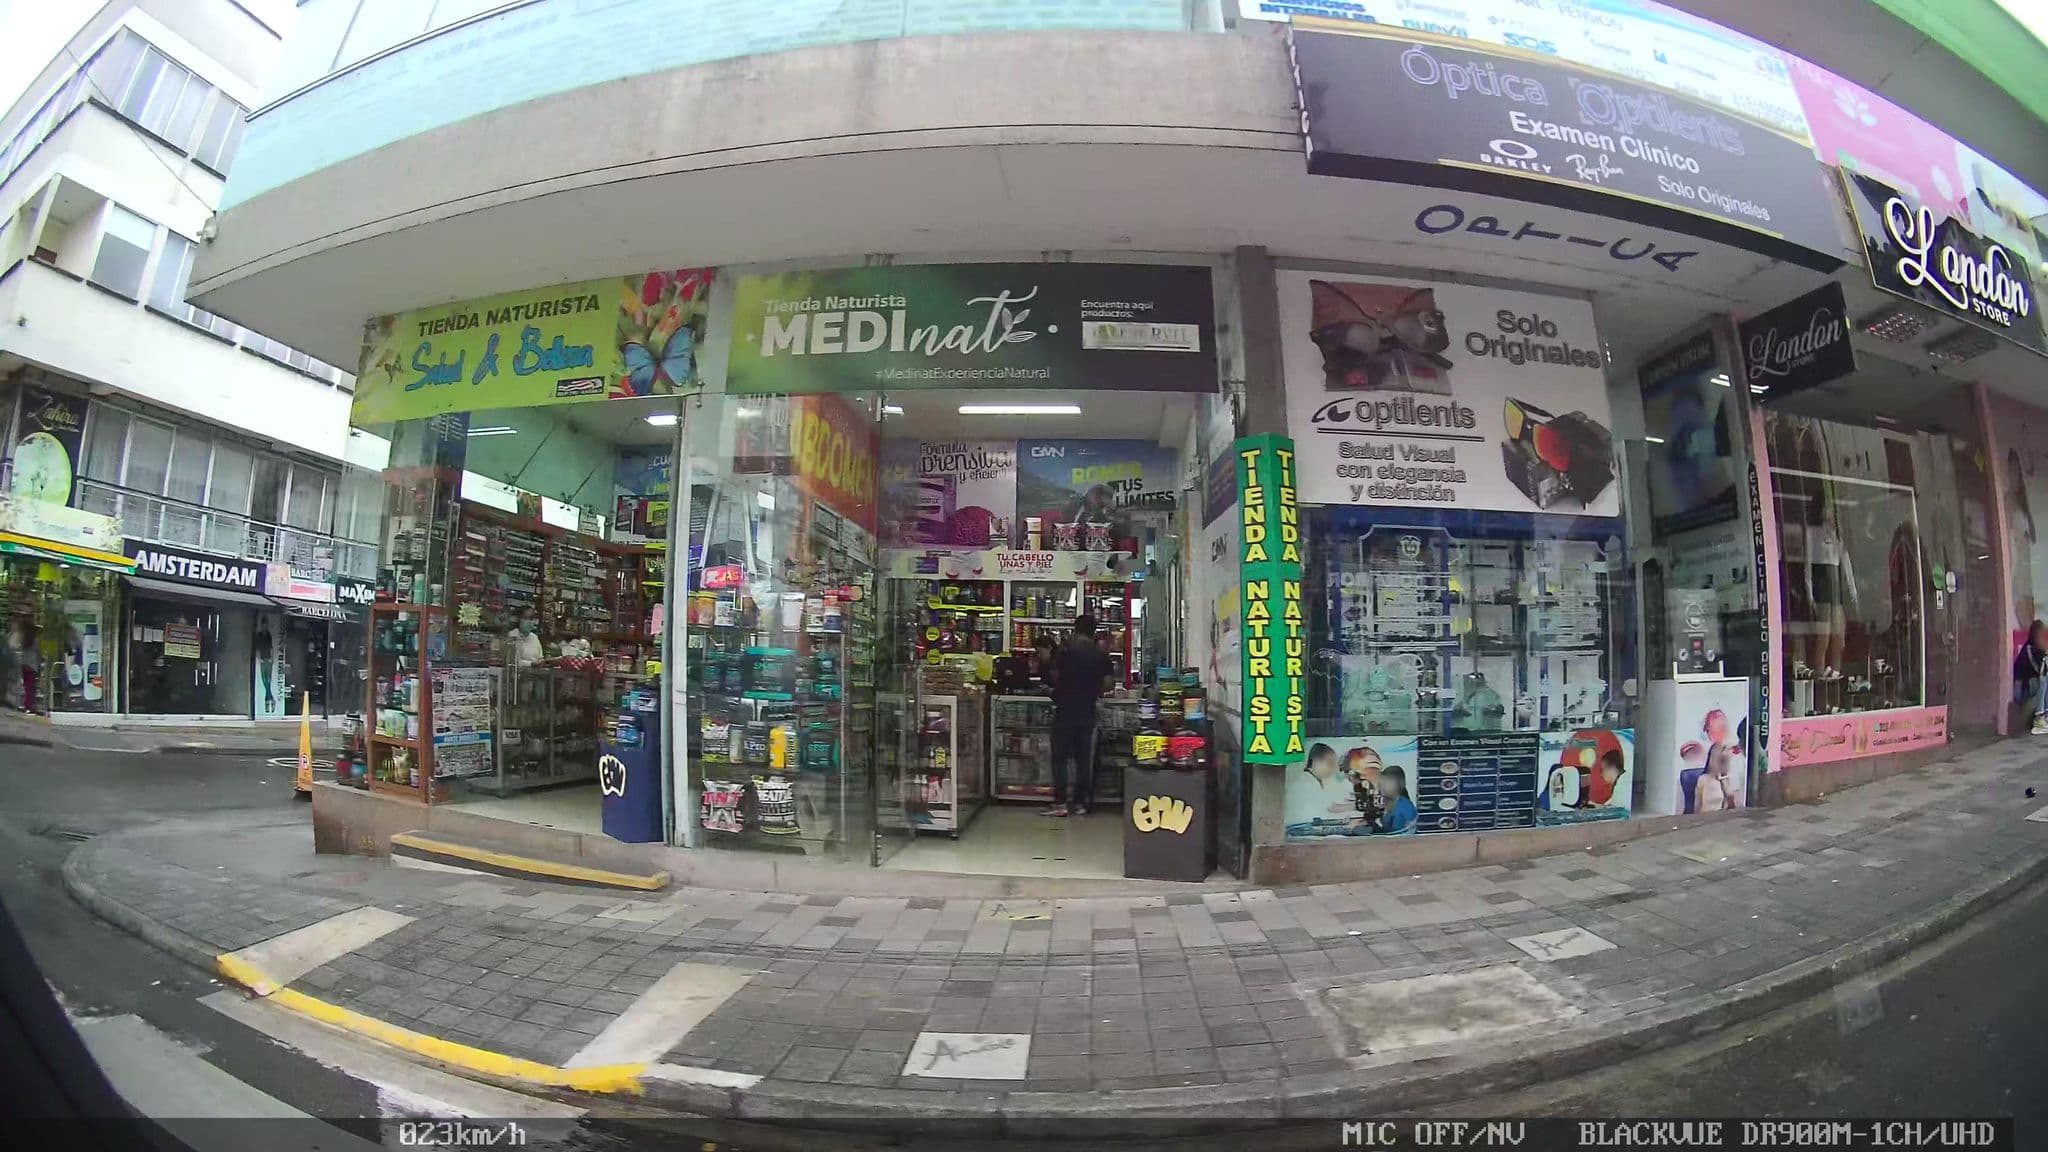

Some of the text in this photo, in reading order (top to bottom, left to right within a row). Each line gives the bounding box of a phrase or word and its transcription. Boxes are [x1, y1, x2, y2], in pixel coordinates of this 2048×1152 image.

[1400, 43, 1548, 107] Óptica
[1508, 110, 1700, 174] Examen Clínico
[1480, 153, 1552, 174] OAKLEY
[1657, 175, 1771, 221] Solo Originales
[1415, 204, 1699, 272] OPTICA
[1884, 197, 2029, 316] London
[417, 294, 601, 337] TIENDA NATURISTA
[764, 294, 907, 313] Tienda Naturista
[1081, 300, 1130, 310] Encuentra
[1973, 296, 2012, 327] STORE
[1496, 309, 1559, 339] Solo
[1464, 330, 1601, 370] Originales
[1749, 308, 1842, 380] London
[1354, 396, 1477, 430] optilents
[1338, 440, 1456, 464] Salud Visual
[1111, 478, 1143, 493] TUS
[1335, 462, 1468, 485] con elegancia
[1349, 483, 1363, 502] y
[1749, 471, 1763, 546] EXAMEN
[133, 549, 258, 588] AMSTERDAM
[996, 553, 1054, 562] TU CABELLO
[1242, 449, 1272, 754] TIENDA NATURISTA
[1277, 449, 1304, 754] TIENDA NATURISTA
[1756, 553, 1769, 642] CLINICO
[1761, 652, 1769, 676] DE
